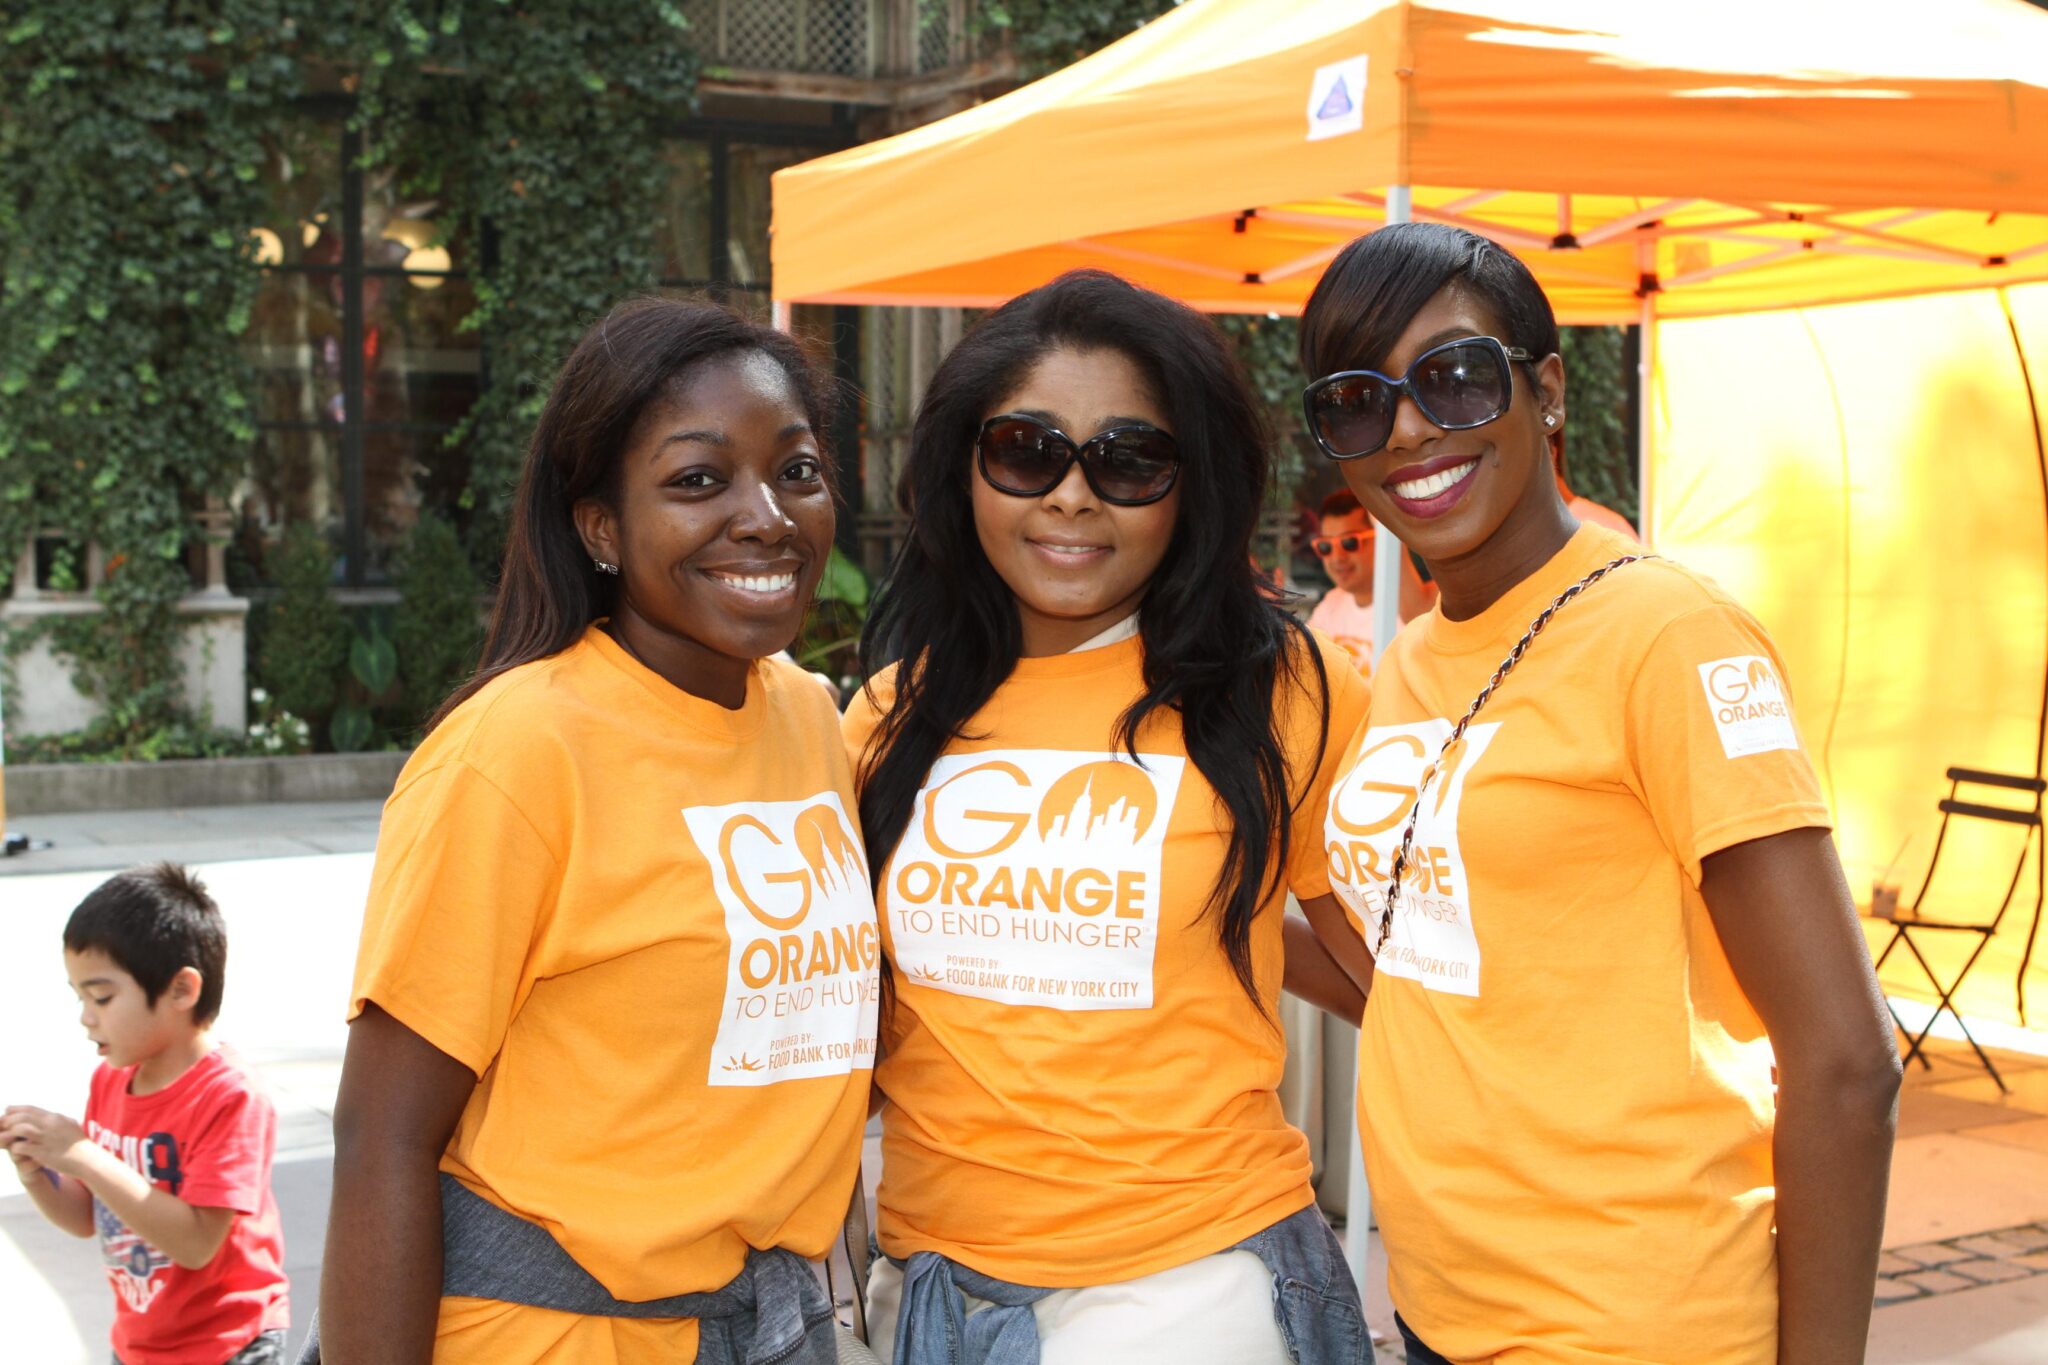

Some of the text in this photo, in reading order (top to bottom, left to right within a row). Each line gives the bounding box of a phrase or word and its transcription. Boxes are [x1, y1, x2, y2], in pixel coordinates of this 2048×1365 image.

[1709, 659, 1777, 704] GO
[1718, 701, 1786, 724] ORANGE
[923, 760, 1157, 859] GO
[718, 803, 870, 931] GO
[1328, 840, 1453, 896] ORAGE
[896, 860, 1146, 919] ORANGE
[898, 910, 1142, 948] TO END HUNGER
[946, 955, 985, 969] POWERED
[946, 969, 1139, 998] FOOD BANK FOR NEW YORK CITY
[736, 994, 767, 1020] TO
[774, 986, 814, 1018] END
[769, 1051, 791, 1071] FOOD
[793, 1046, 824, 1065] BANK
[827, 1042, 851, 1061] FOR
[770, 1034, 798, 1051] POWERED
